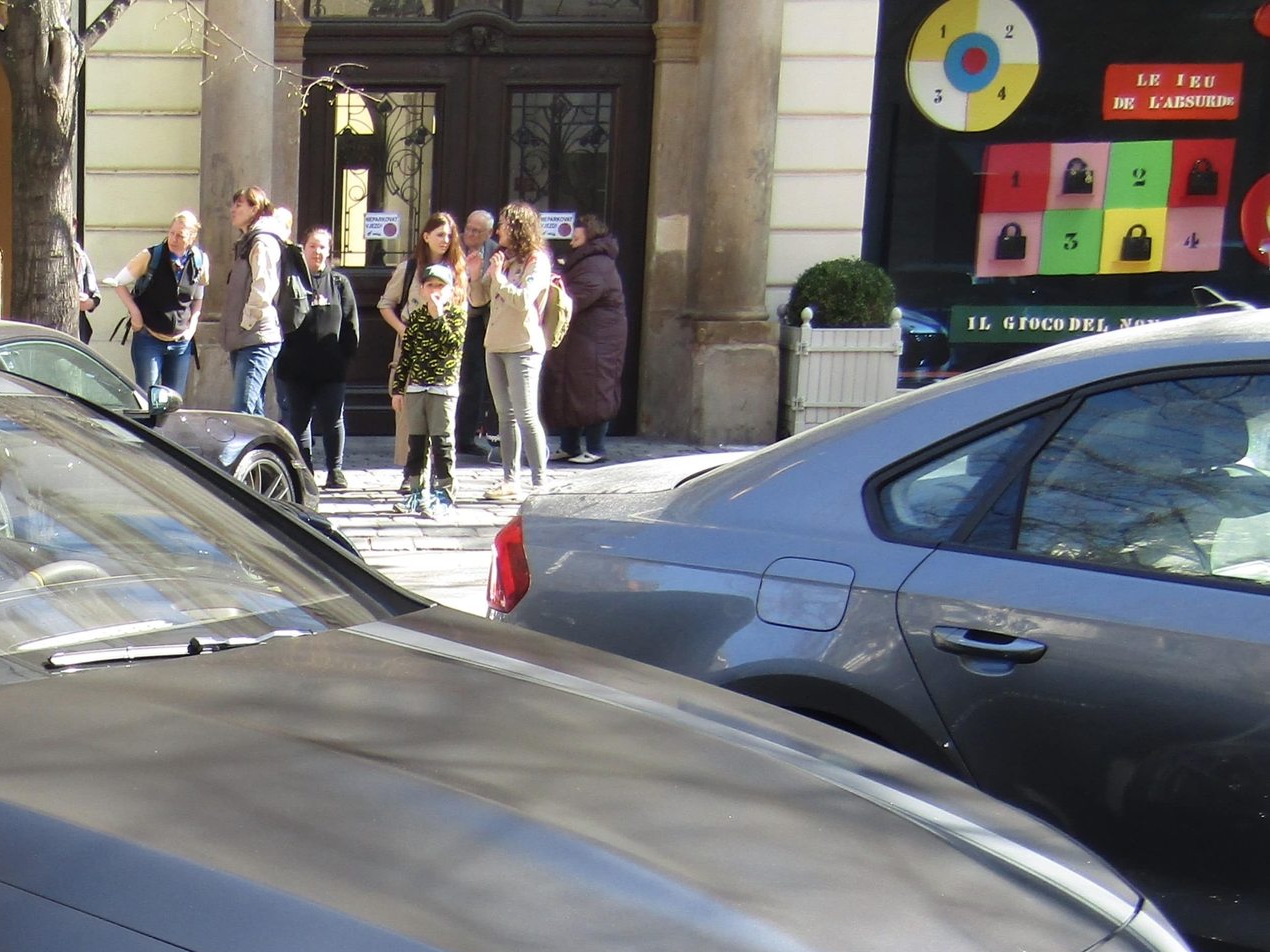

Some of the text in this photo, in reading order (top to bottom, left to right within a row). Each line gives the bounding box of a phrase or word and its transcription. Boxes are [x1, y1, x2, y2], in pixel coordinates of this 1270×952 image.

[940, 24, 946, 38] 1
[1004, 24, 1014, 39] 2
[1136, 73, 1161, 87] LE
[934, 89, 943, 104] 3
[997, 86, 1007, 101] 4
[1113, 94, 1235, 110] DE L'ABSURDE
[1011, 170, 1020, 188] 1
[1132, 168, 1146, 187] 2
[1063, 232, 1078, 250] 3
[1184, 232, 1200, 249] 4
[968, 316, 991, 331] IL
[1003, 316, 1064, 331] GIOCO
[1068, 317, 1108, 332] DEL
